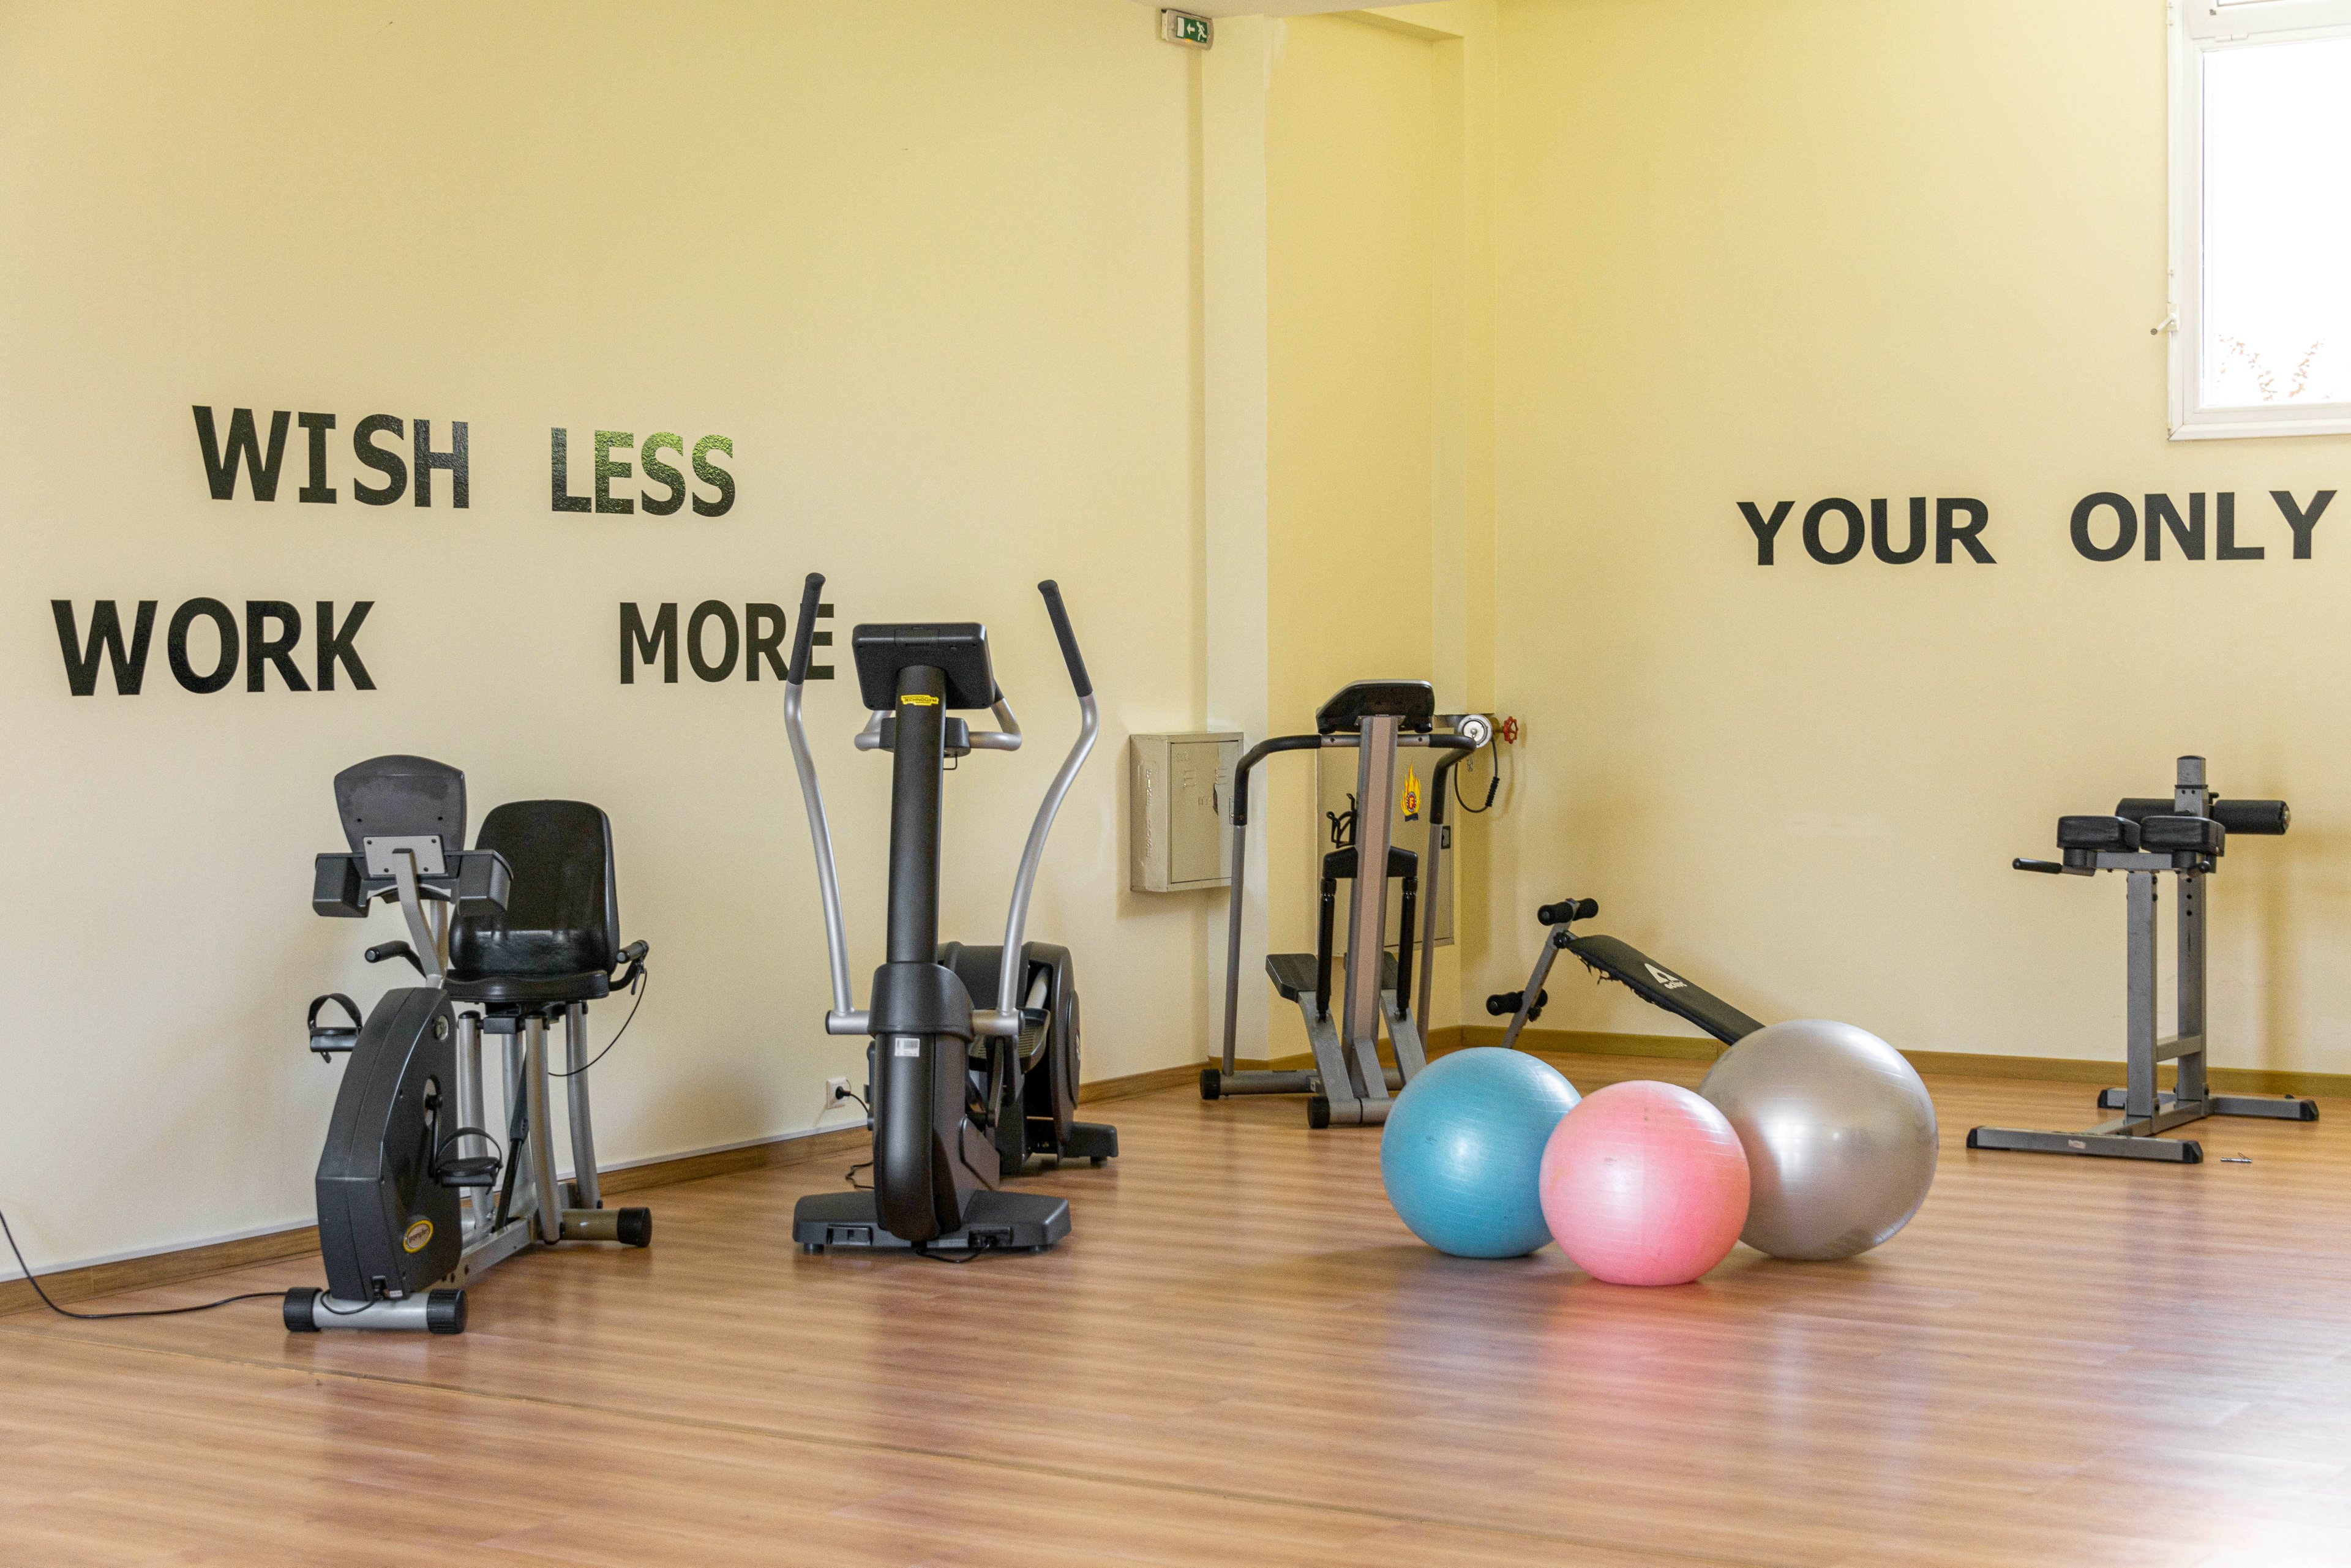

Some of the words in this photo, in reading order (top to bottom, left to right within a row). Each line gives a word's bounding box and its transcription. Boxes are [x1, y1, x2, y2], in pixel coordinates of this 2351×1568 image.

[192, 405, 469, 509] WISH
[551, 427, 736, 517] LESS
[1736, 497, 1997, 566] YOUR
[2070, 490, 2338, 562] ONLY
[50, 597, 377, 697] WORK
[620, 599, 834, 685] MORE
